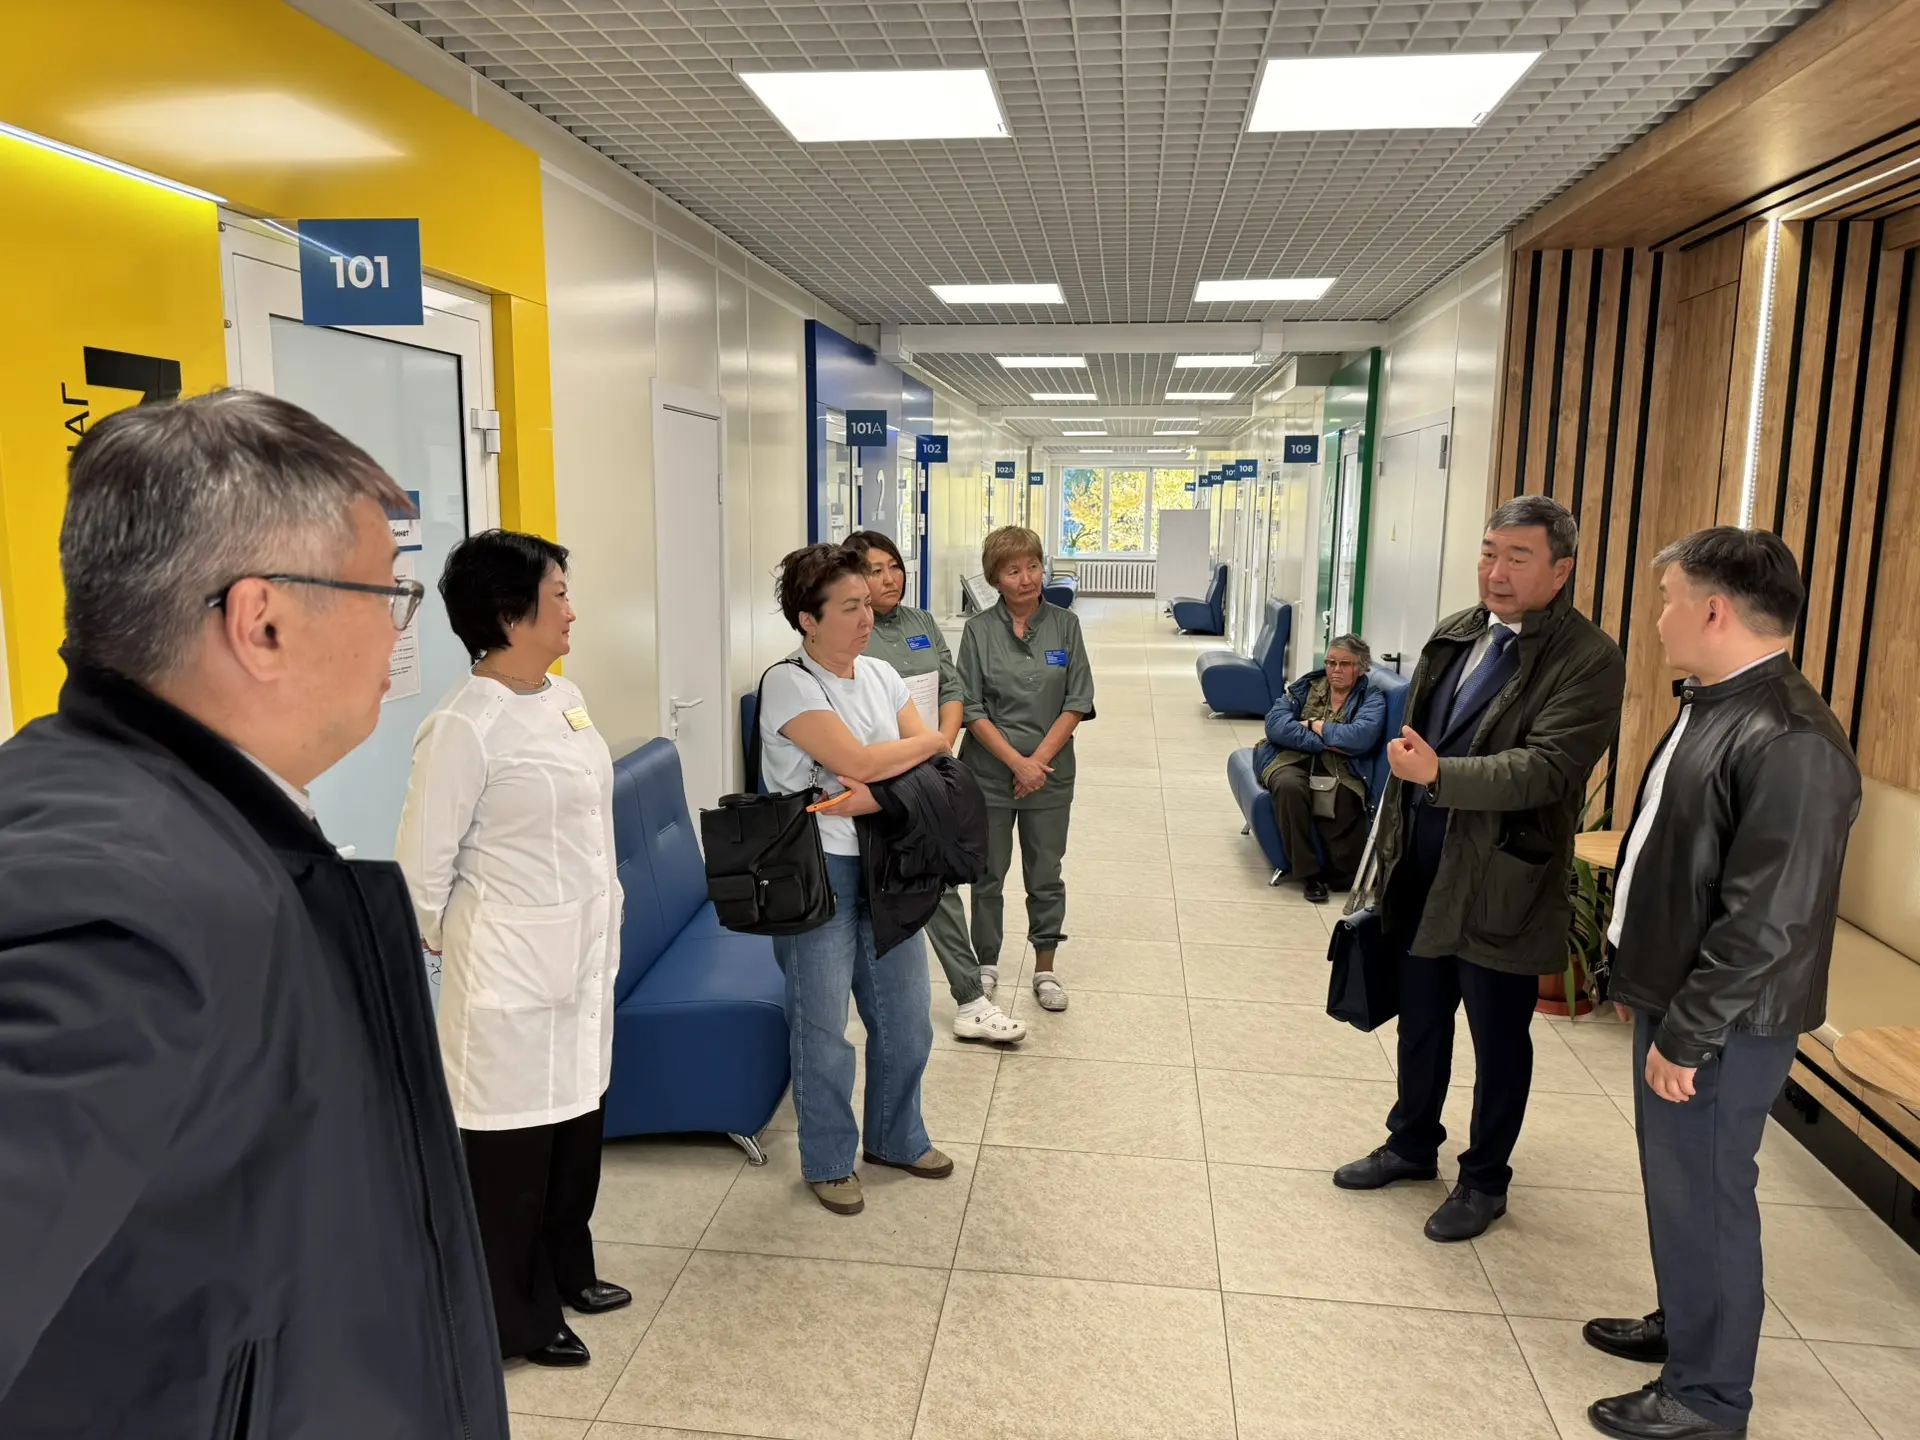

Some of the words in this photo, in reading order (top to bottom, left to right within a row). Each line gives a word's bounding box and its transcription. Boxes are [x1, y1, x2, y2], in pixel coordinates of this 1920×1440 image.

[329, 255, 389, 289] 101
[61, 381, 89, 452] АГ
[851, 422, 883, 435] 101A
[922, 443, 942, 454] 102
[1290, 444, 1312, 454] 109
[997, 466, 1014, 474] 102A
[1239, 465, 1254, 473] 108
